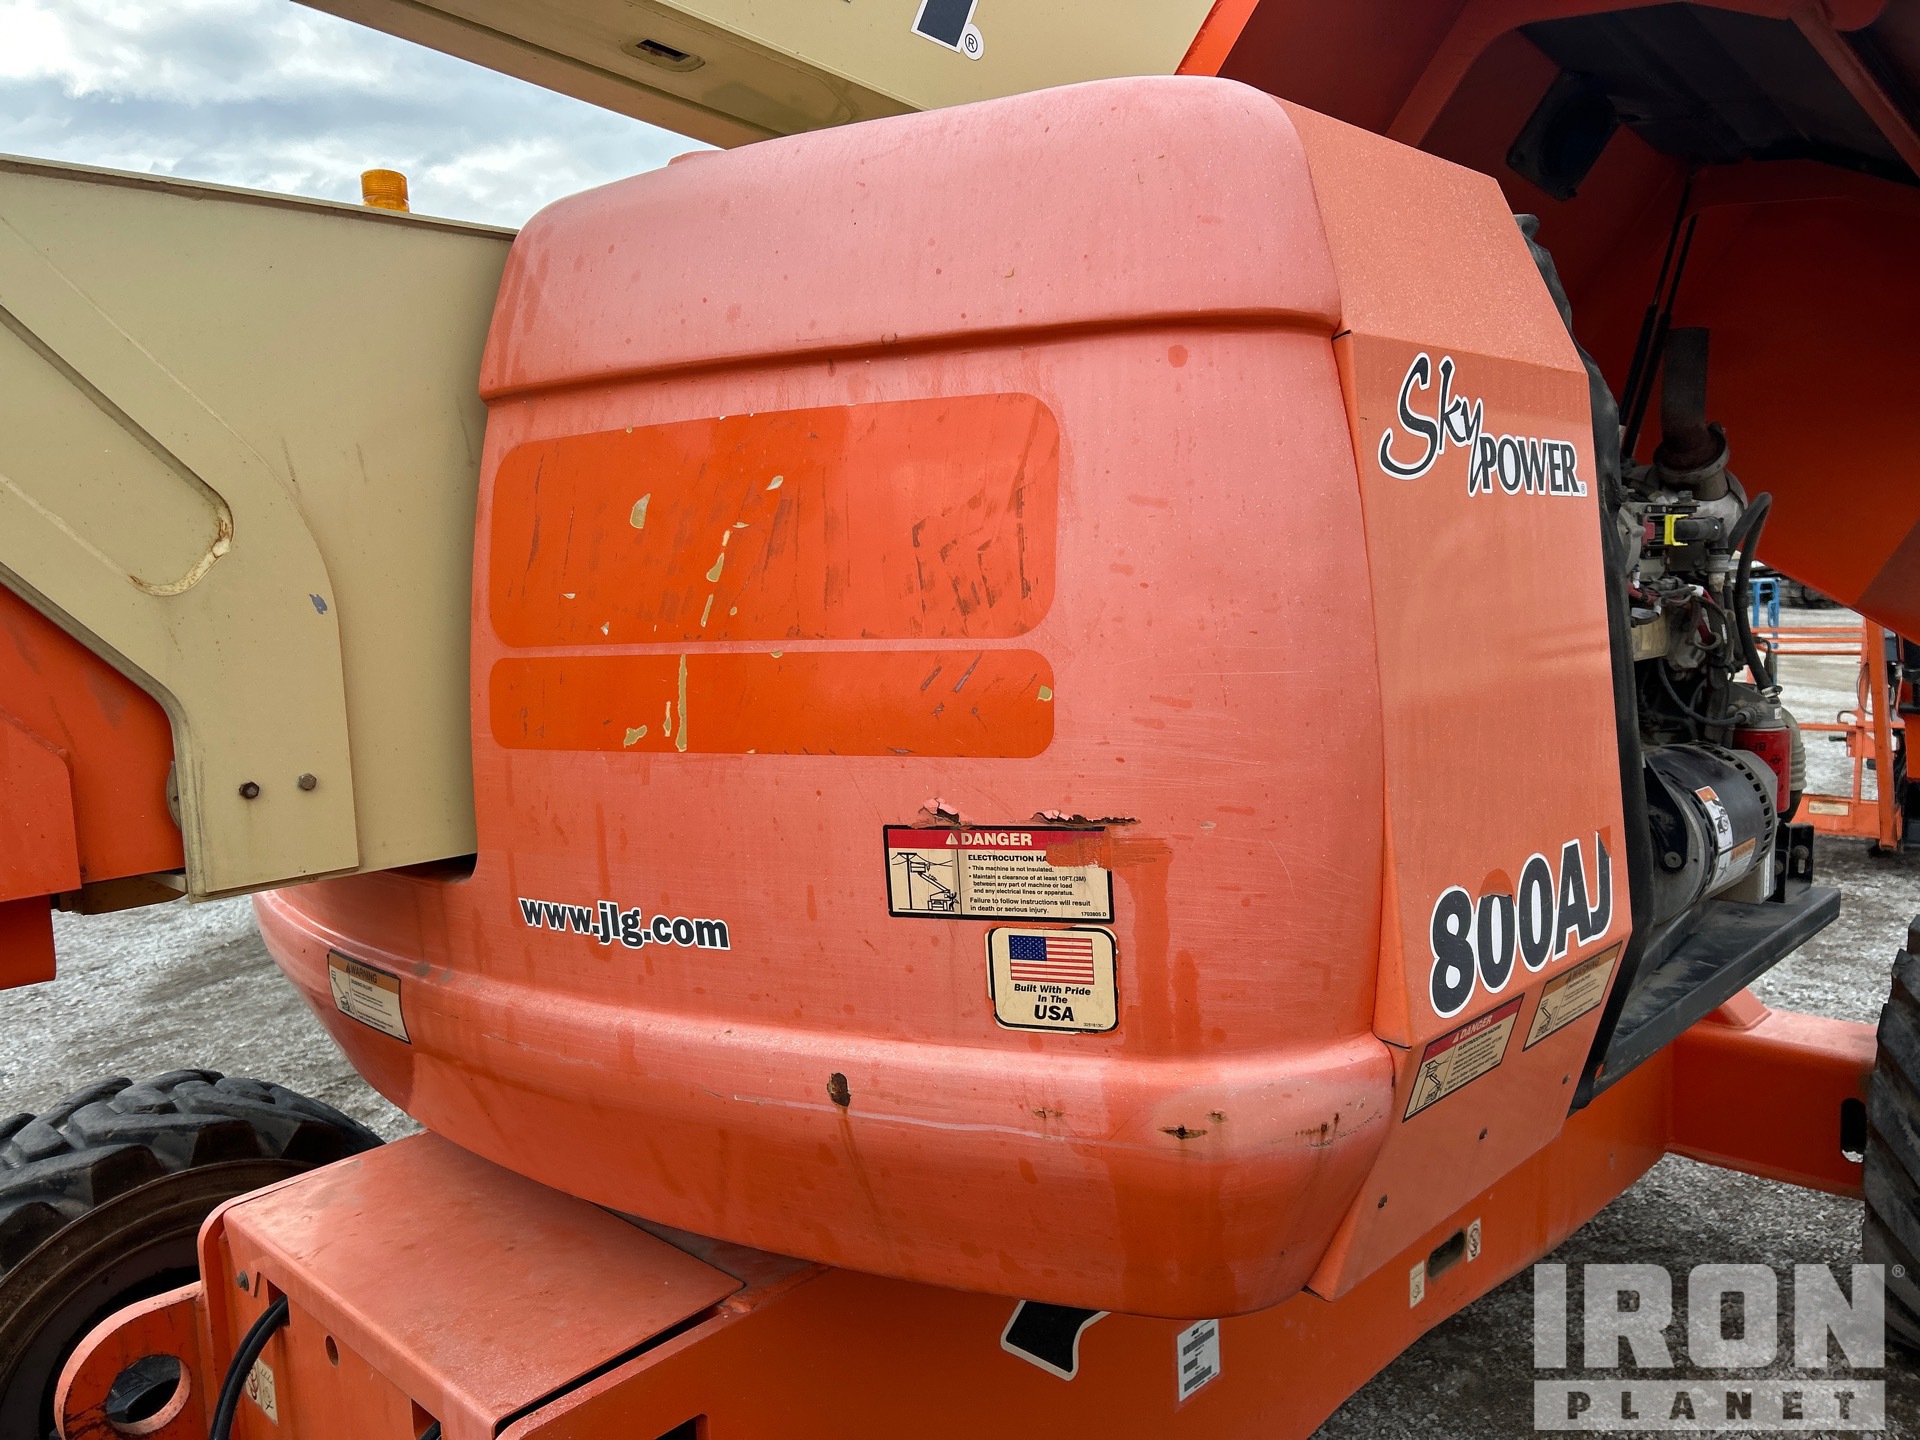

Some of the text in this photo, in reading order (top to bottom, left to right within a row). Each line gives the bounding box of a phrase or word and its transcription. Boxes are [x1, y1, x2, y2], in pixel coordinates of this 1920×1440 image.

[961, 832, 1032, 846] DANGER
[968, 854, 1034, 862] ELECTROCUTION
[519, 898, 730, 949] www.jlg.com
[1430, 830, 1613, 1018] 800AJ
[1014, 983, 1091, 996] Built With Pride
[1038, 995, 1068, 1004] In The
[1034, 1004, 1074, 1022] USA
[1460, 1014, 1493, 1040] DANGER
